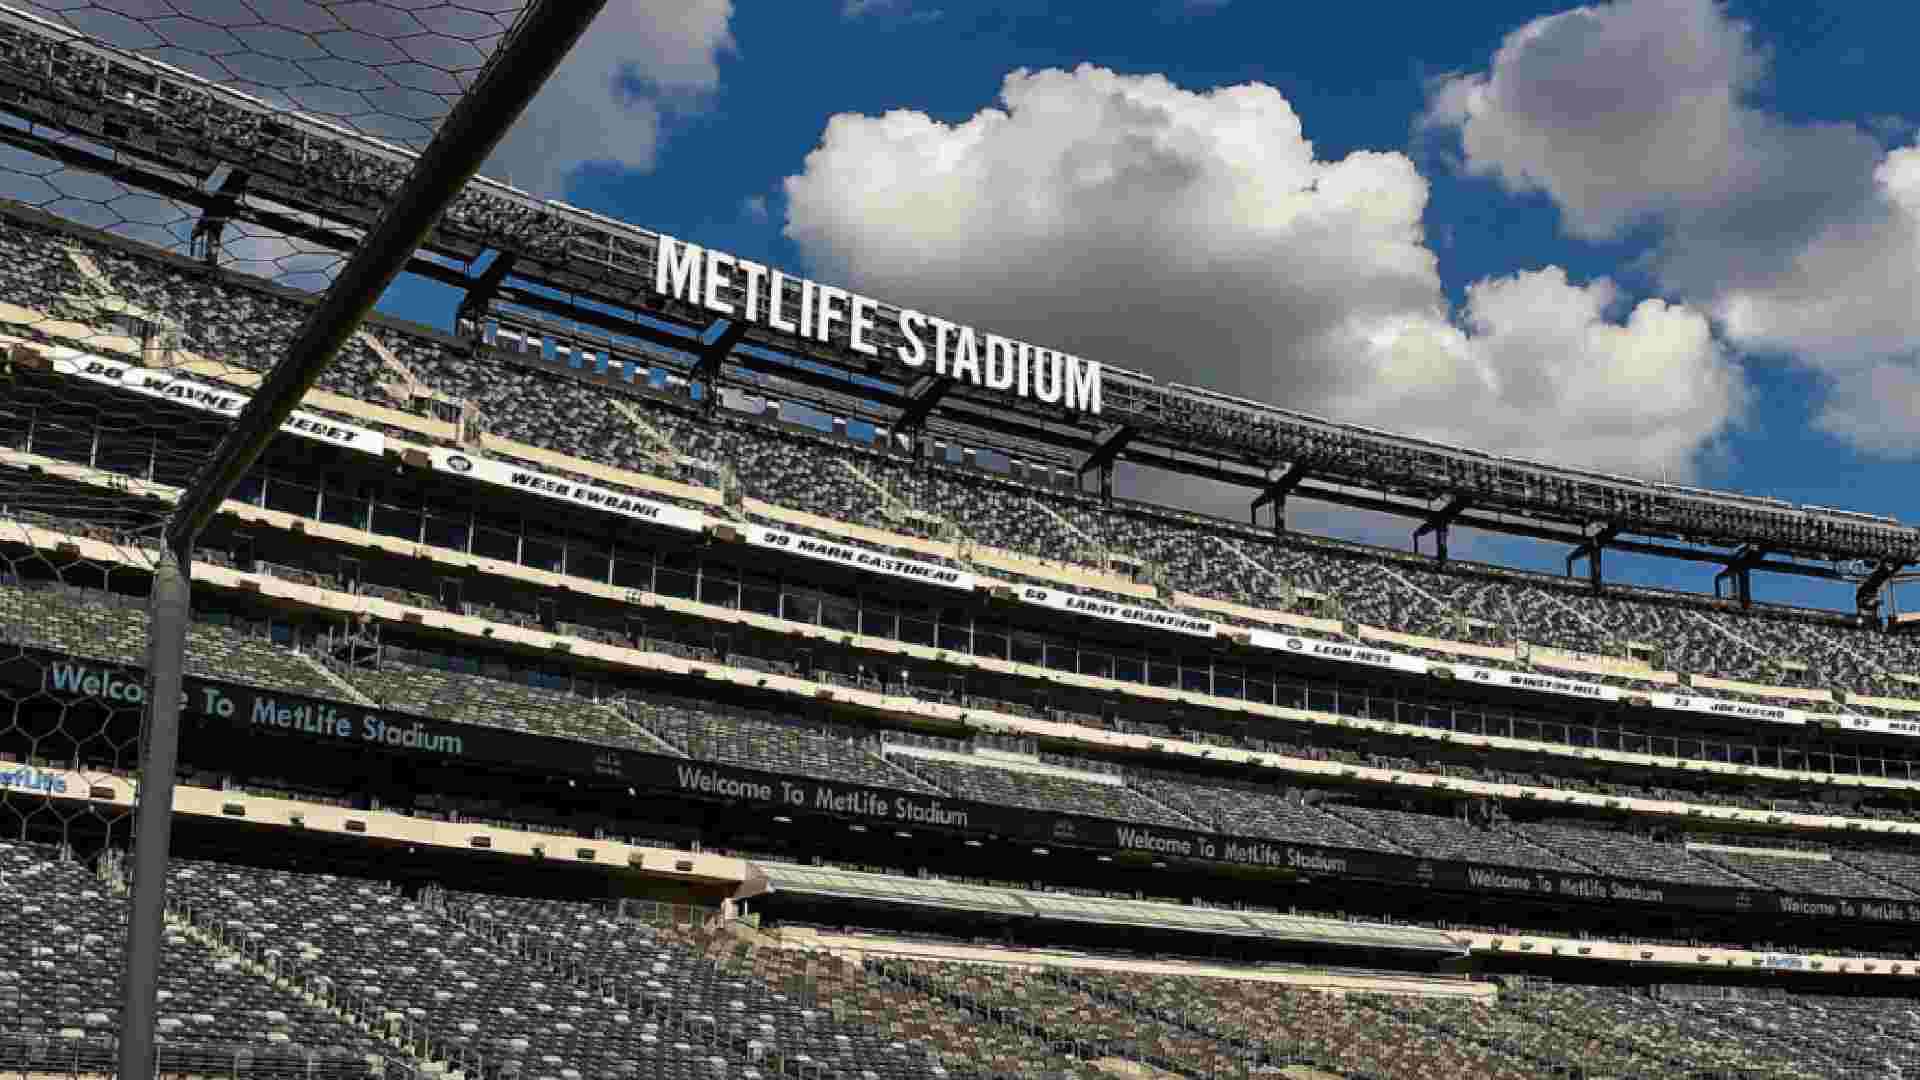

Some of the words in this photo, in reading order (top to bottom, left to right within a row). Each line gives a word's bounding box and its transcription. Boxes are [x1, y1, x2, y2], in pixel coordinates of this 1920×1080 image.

[655, 234, 878, 355] METLIFE
[898, 309, 1102, 414] STADIUM
[511, 471, 570, 499] WEEB
[574, 482, 662, 518] EWBANK
[762, 531, 790, 546] 99
[797, 539, 854, 561] MARK
[1313, 643, 1352, 657] LEON
[50, 662, 189, 711] Welcoe
[202, 688, 234, 717] To
[252, 697, 353, 738] MetLife
[361, 713, 463, 754] Stadium
[677, 764, 772, 800] Welcome
[780, 781, 805, 805] To
[815, 788, 888, 817] MetLife
[895, 798, 968, 826] Stadium
[1116, 826, 1192, 855] Welcome
[1199, 838, 1215, 857] To
[1224, 842, 1281, 865] MetLife
[1287, 849, 1346, 873] Stadium
[1468, 863, 1530, 890] Welcome
[1536, 875, 1552, 892] To
[1560, 879, 1607, 897] MetLife
[1779, 896, 1836, 914] Welcome
[1840, 901, 1856, 916] To
